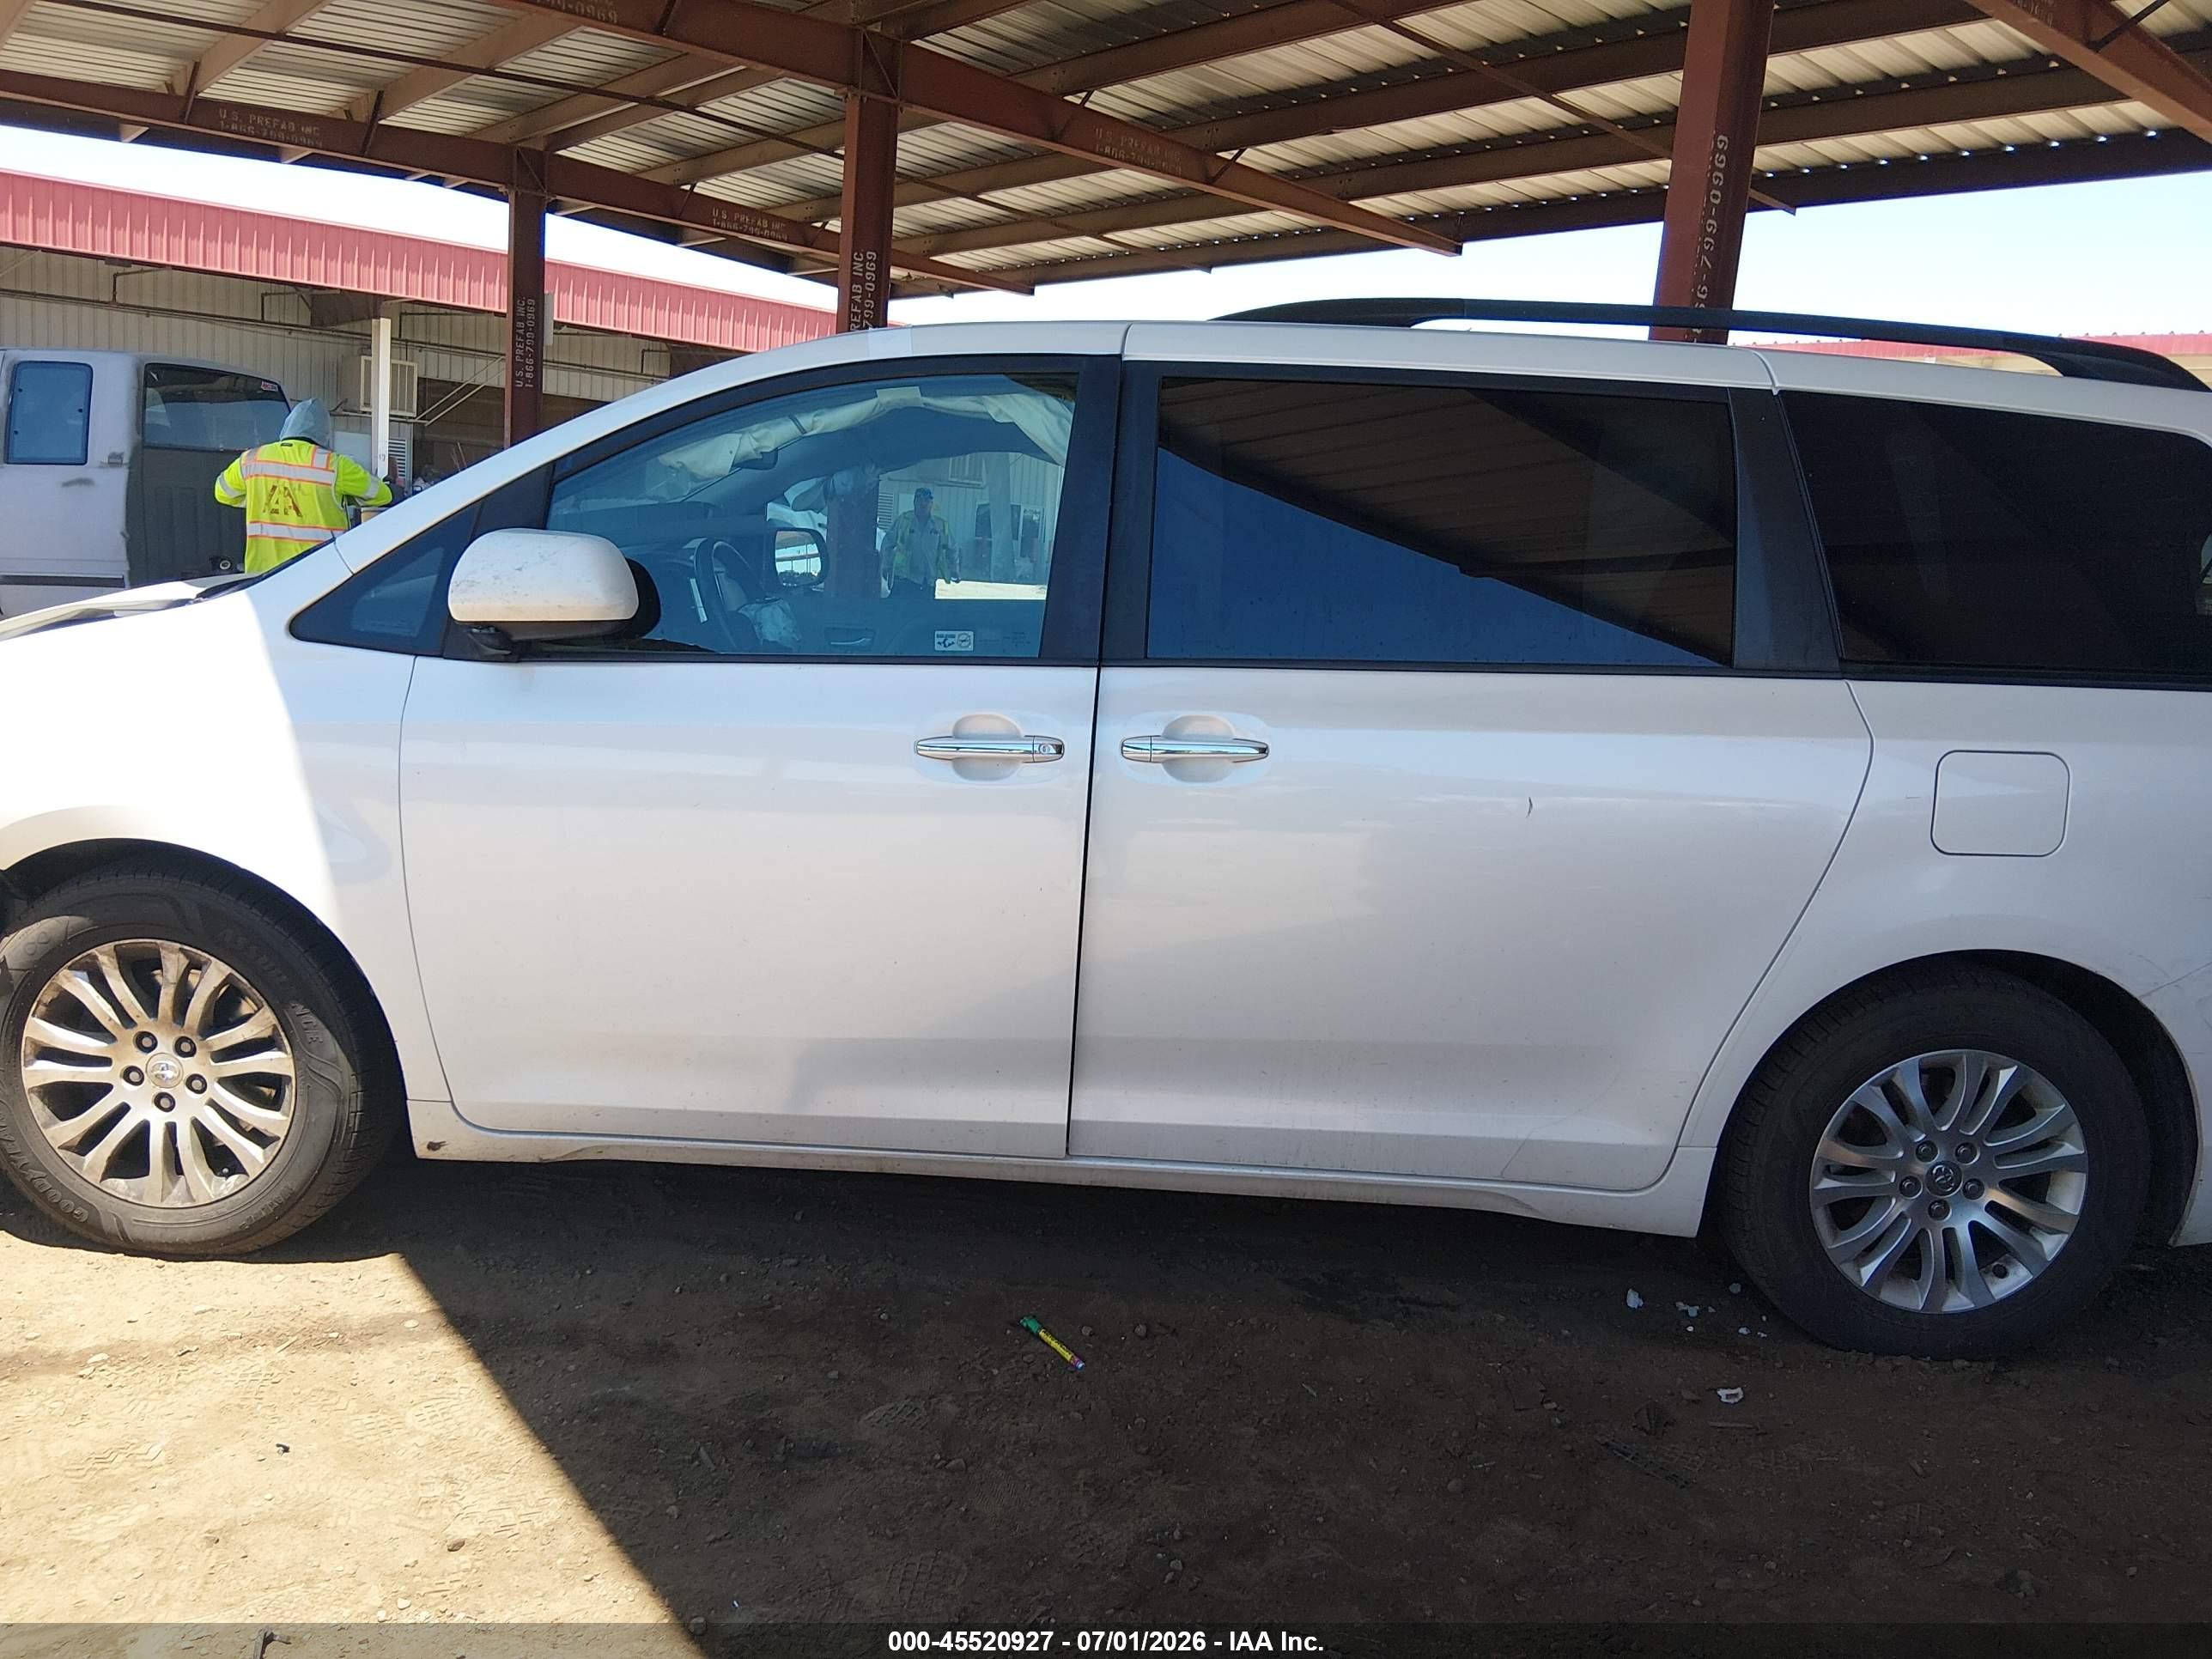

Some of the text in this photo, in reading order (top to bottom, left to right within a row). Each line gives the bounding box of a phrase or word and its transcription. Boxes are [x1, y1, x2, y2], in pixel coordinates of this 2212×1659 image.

[850, 284, 863, 331] REFAB
[862, 251, 877, 331] 799-0969
[515, 321, 526, 362] PREFAB
[525, 298, 536, 388] 1-866-799-0969
